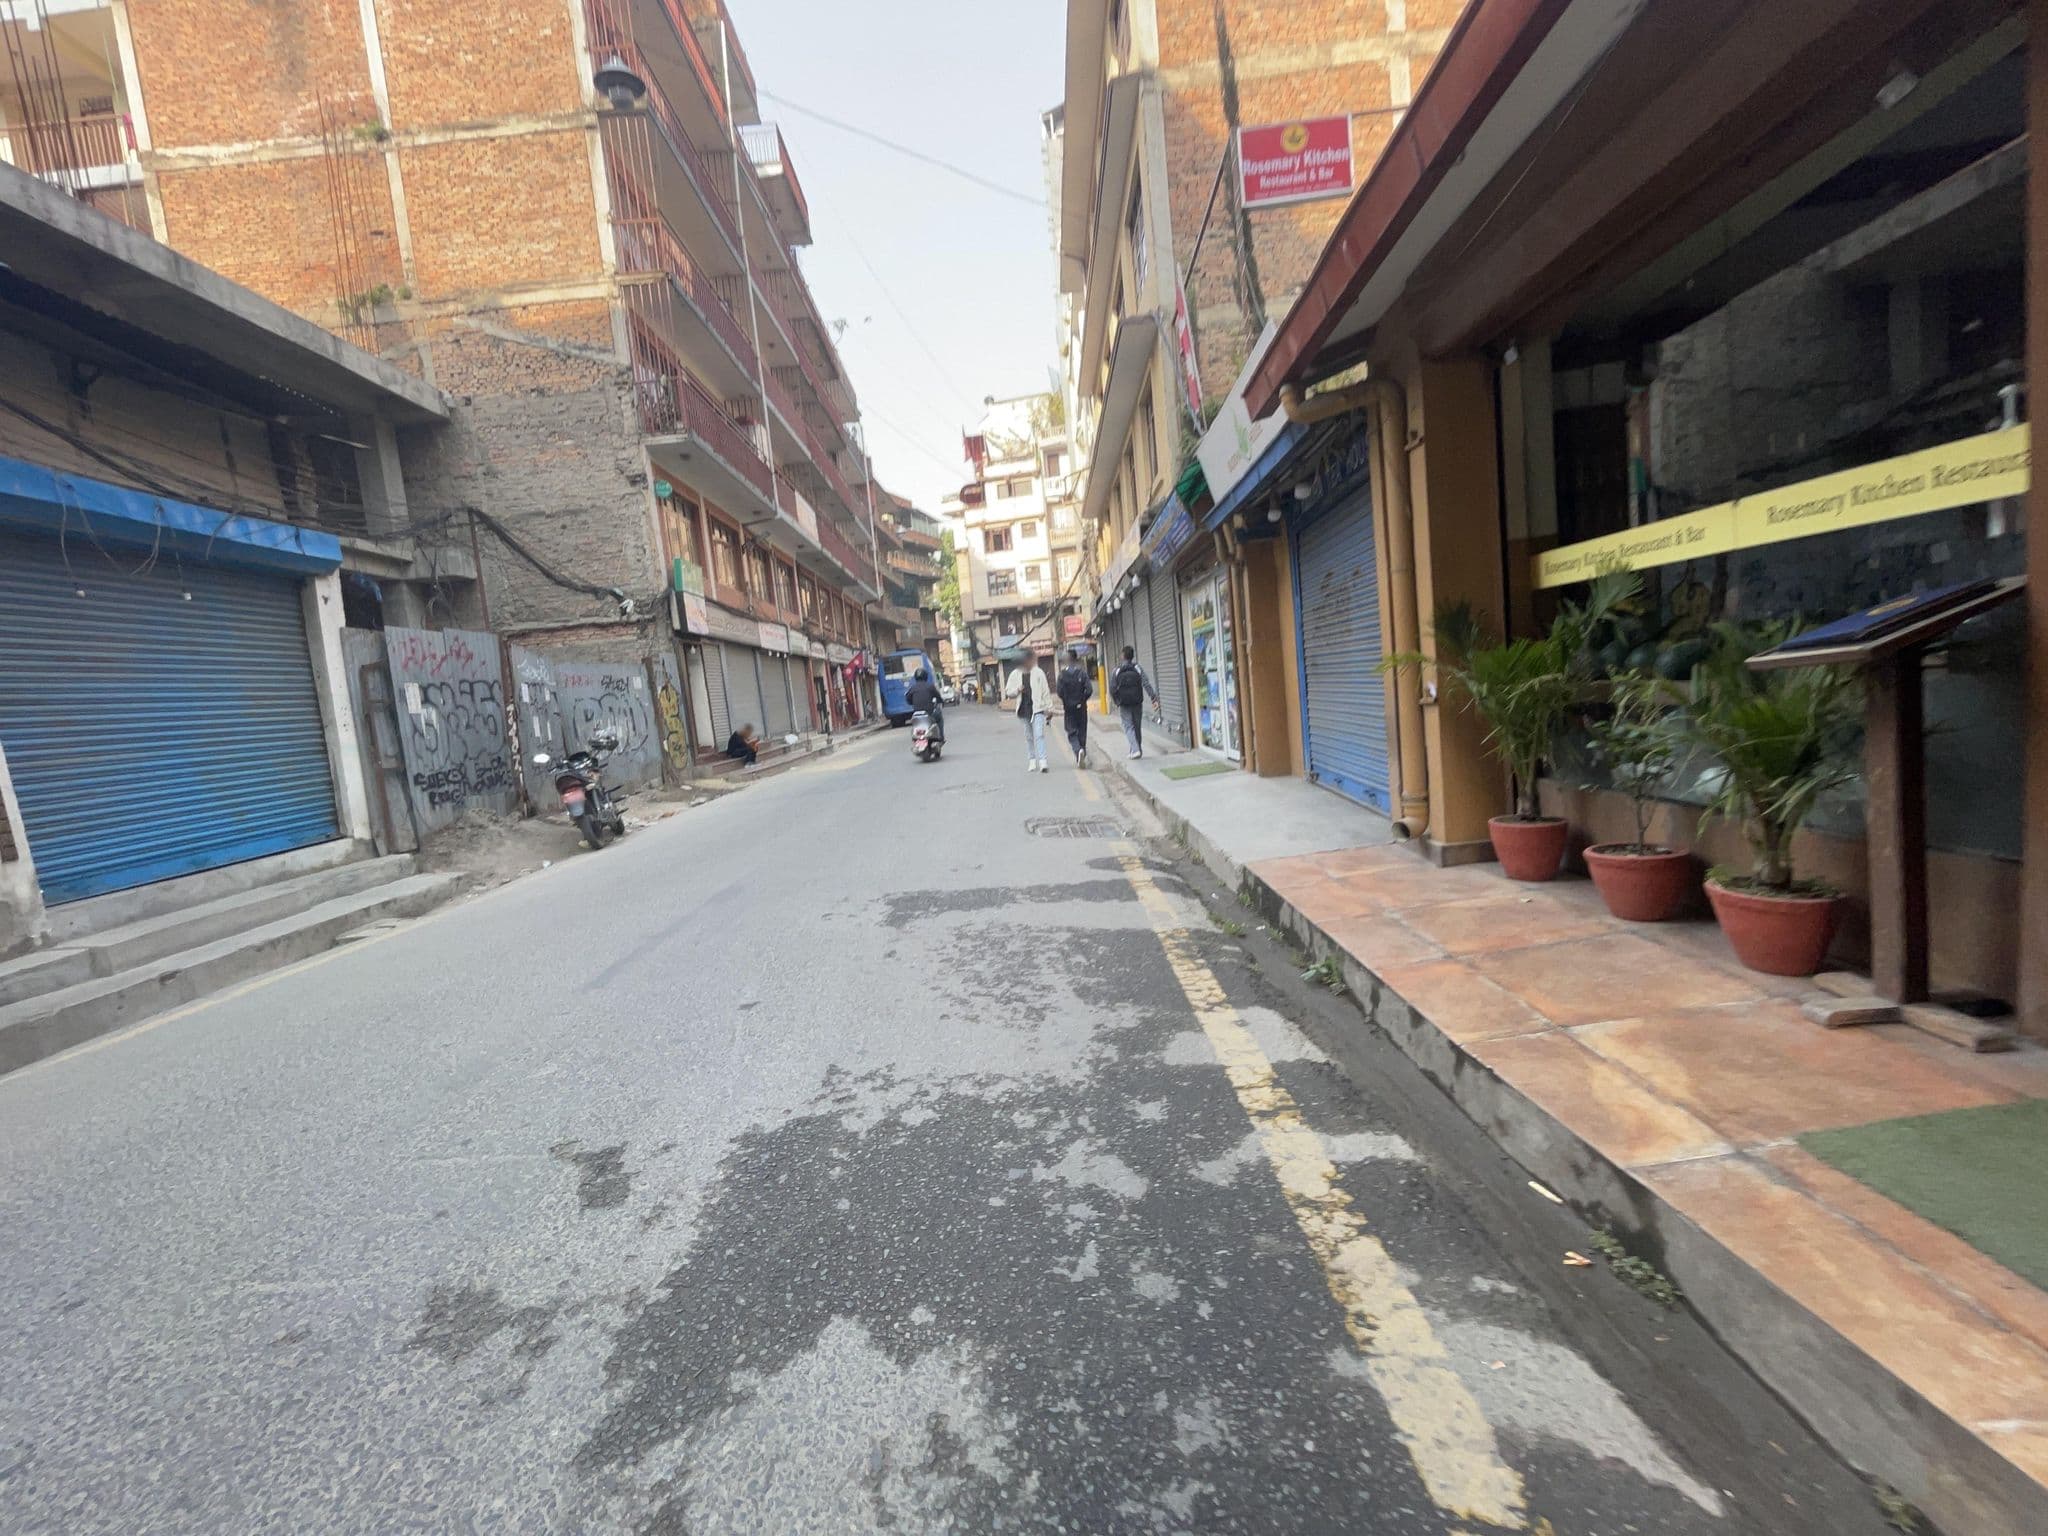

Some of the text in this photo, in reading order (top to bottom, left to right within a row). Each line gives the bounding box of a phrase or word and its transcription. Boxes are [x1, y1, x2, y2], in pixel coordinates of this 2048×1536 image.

[1243, 146, 1350, 176] Rosemary Kitchen
[1260, 170, 1307, 190] Restaurant
[1309, 167, 1317, 183] &
[1318, 166, 1335, 182] Bar
[1767, 493, 1847, 526] Rosemary
[1850, 474, 1926, 506] Kitchen
